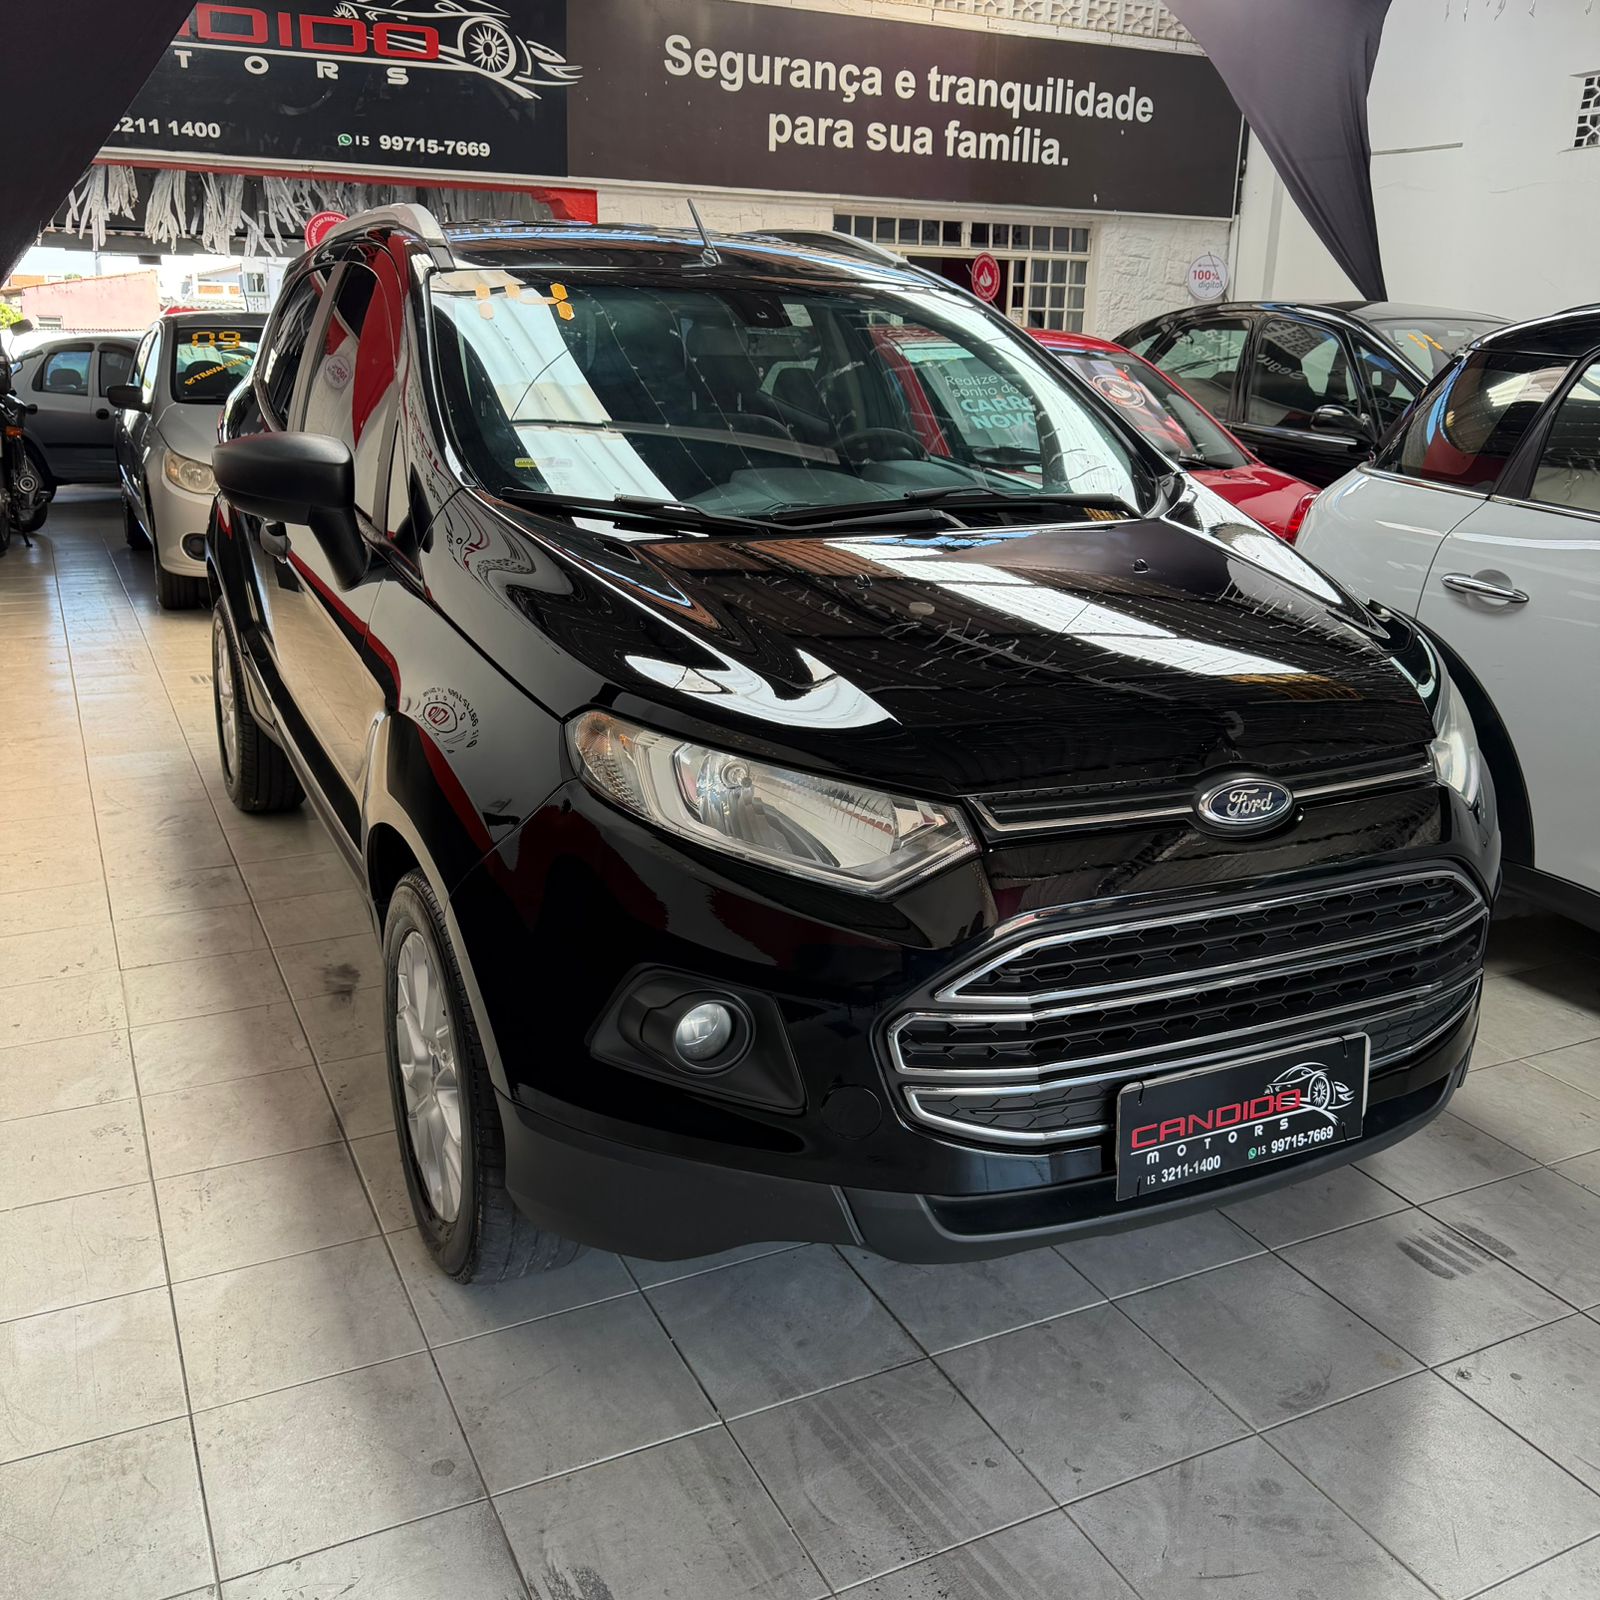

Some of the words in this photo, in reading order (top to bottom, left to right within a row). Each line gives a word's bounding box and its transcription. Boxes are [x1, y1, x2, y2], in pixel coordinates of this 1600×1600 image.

[176, 3, 440, 60] DIDO
[664, 34, 883, 103] Segurança
[894, 70, 917, 99] e
[928, 65, 1154, 123] tranquilidade
[168, 120, 221, 138] 1400
[768, 113, 854, 152] para
[866, 122, 933, 155] sua
[944, 120, 1069, 166] família.
[379, 134, 491, 157] 99715-7669
[1192, 270, 1220, 280] 100%
[192, 331, 241, 350] 09
[944, 375, 998, 387] Realize
[952, 387, 998, 398] sonho
[1001, 383, 1019, 395] do
[1226, 788, 1274, 817] Ford
[1131, 1088, 1301, 1149] CANDIDO
[1271, 1125, 1334, 1154] 99715-7669
[1161, 1155, 1221, 1183] 3211-1400
